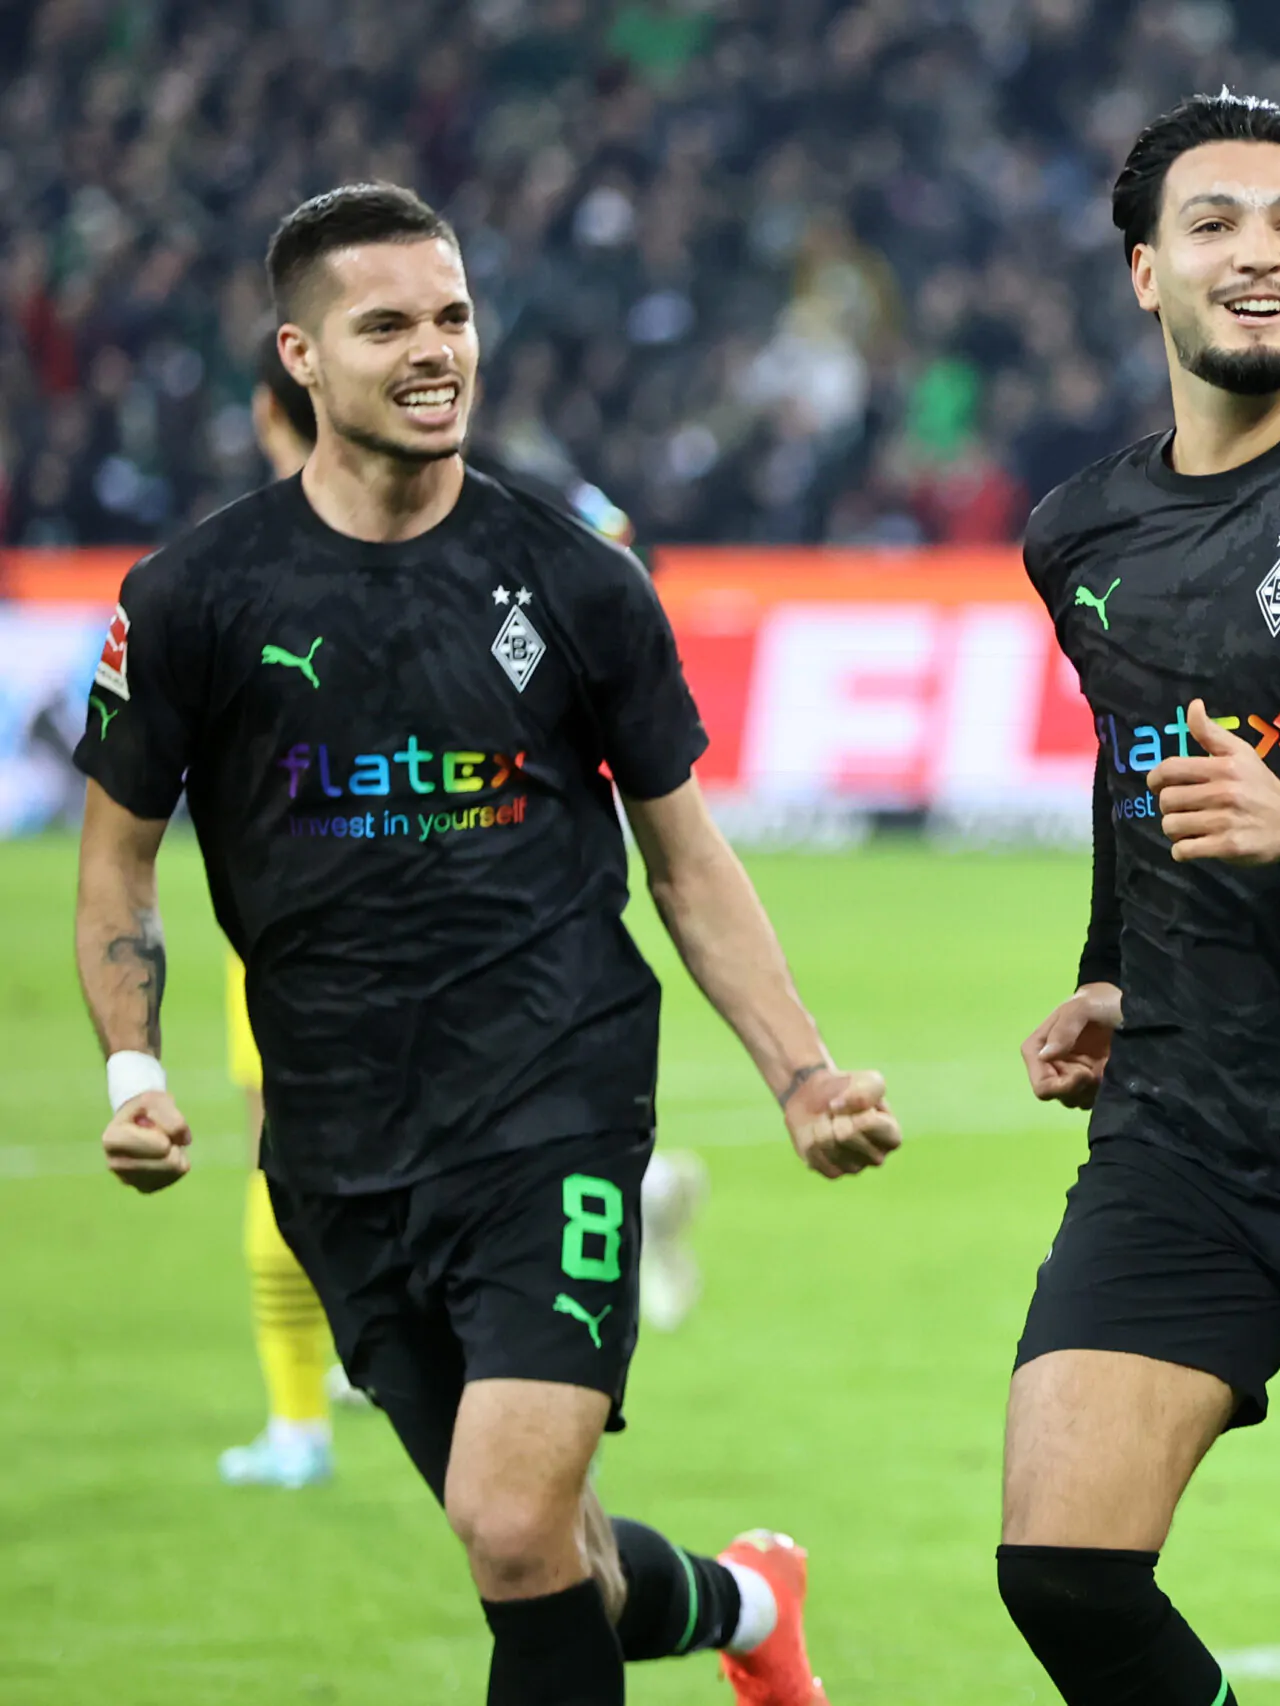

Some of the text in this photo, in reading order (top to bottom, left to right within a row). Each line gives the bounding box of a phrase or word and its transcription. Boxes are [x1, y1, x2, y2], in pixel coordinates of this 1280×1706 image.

[383, 809, 409, 836] in
[418, 795, 527, 842] yourself
[561, 1173, 624, 1282] 8
